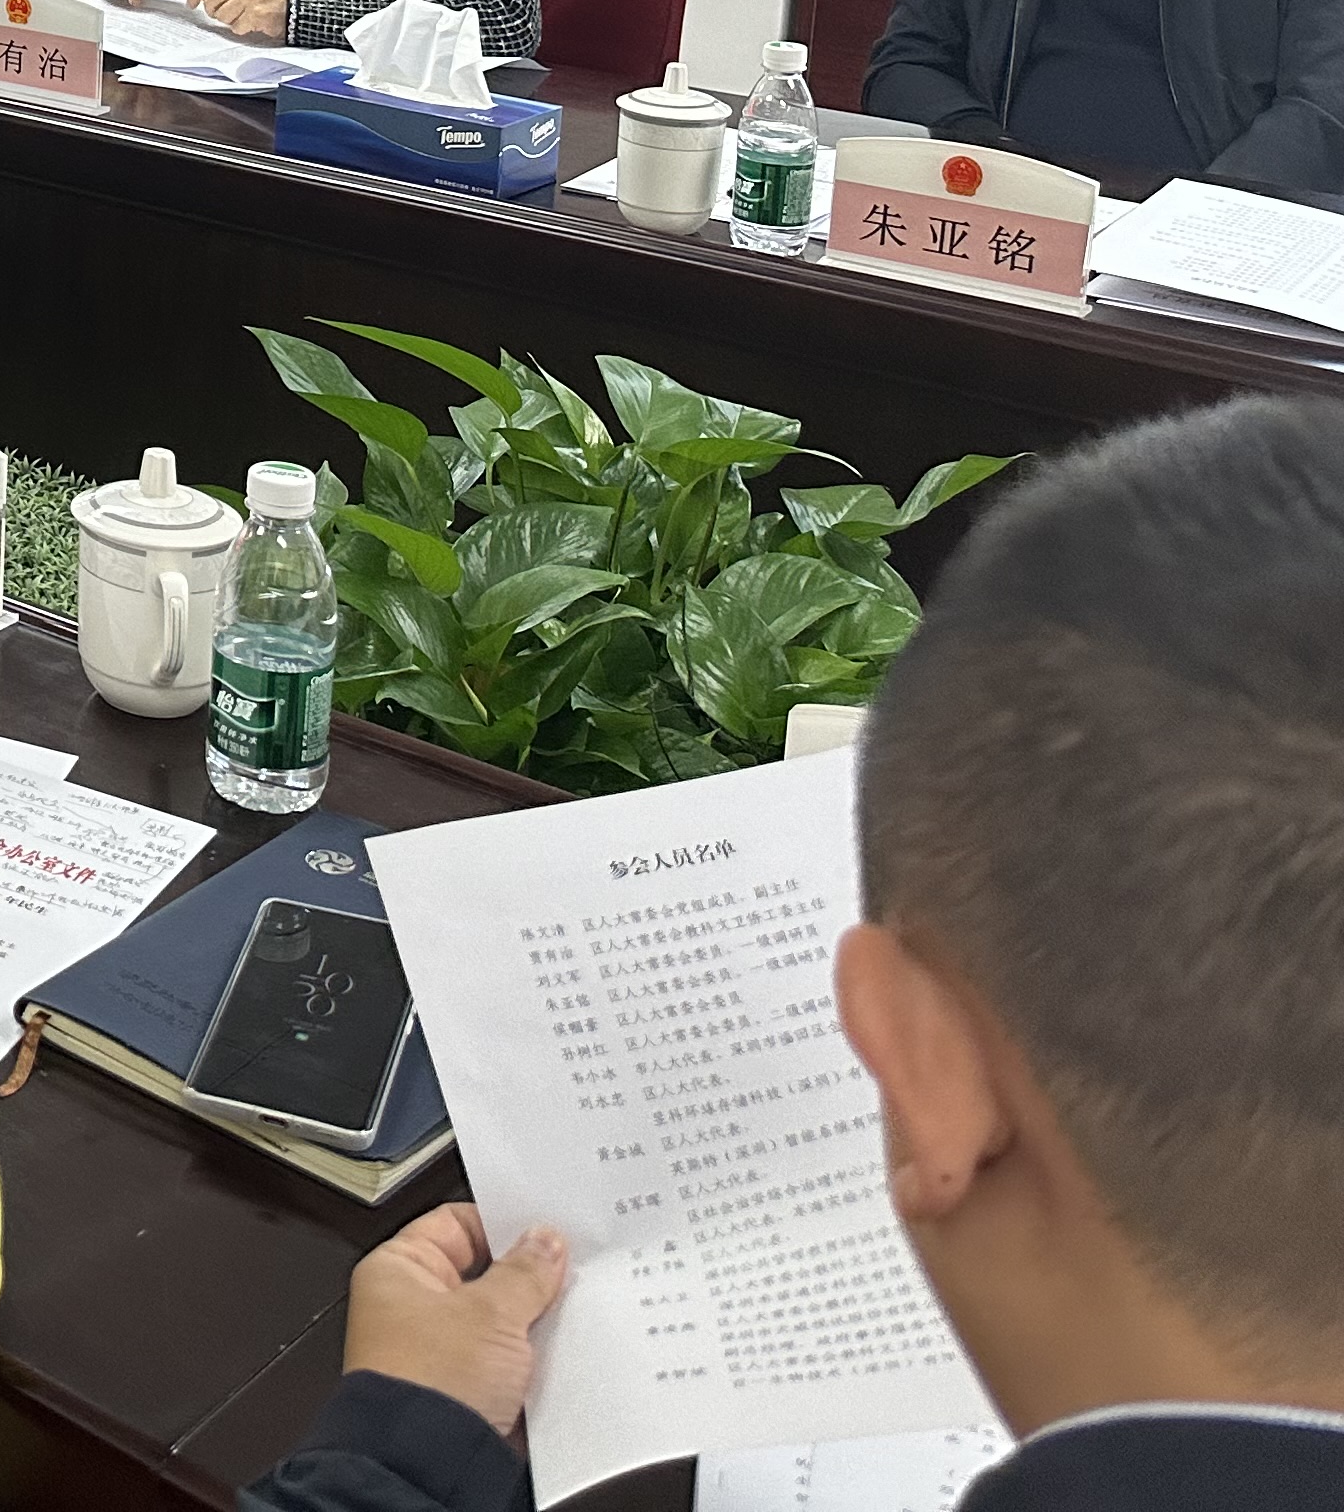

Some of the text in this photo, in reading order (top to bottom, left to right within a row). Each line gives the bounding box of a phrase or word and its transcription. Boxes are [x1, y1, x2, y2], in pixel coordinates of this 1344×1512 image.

[436, 125, 486, 149] Tempo
[859, 203, 1037, 274] 朱亚铭
[609, 837, 737, 879] 参会人员名单
